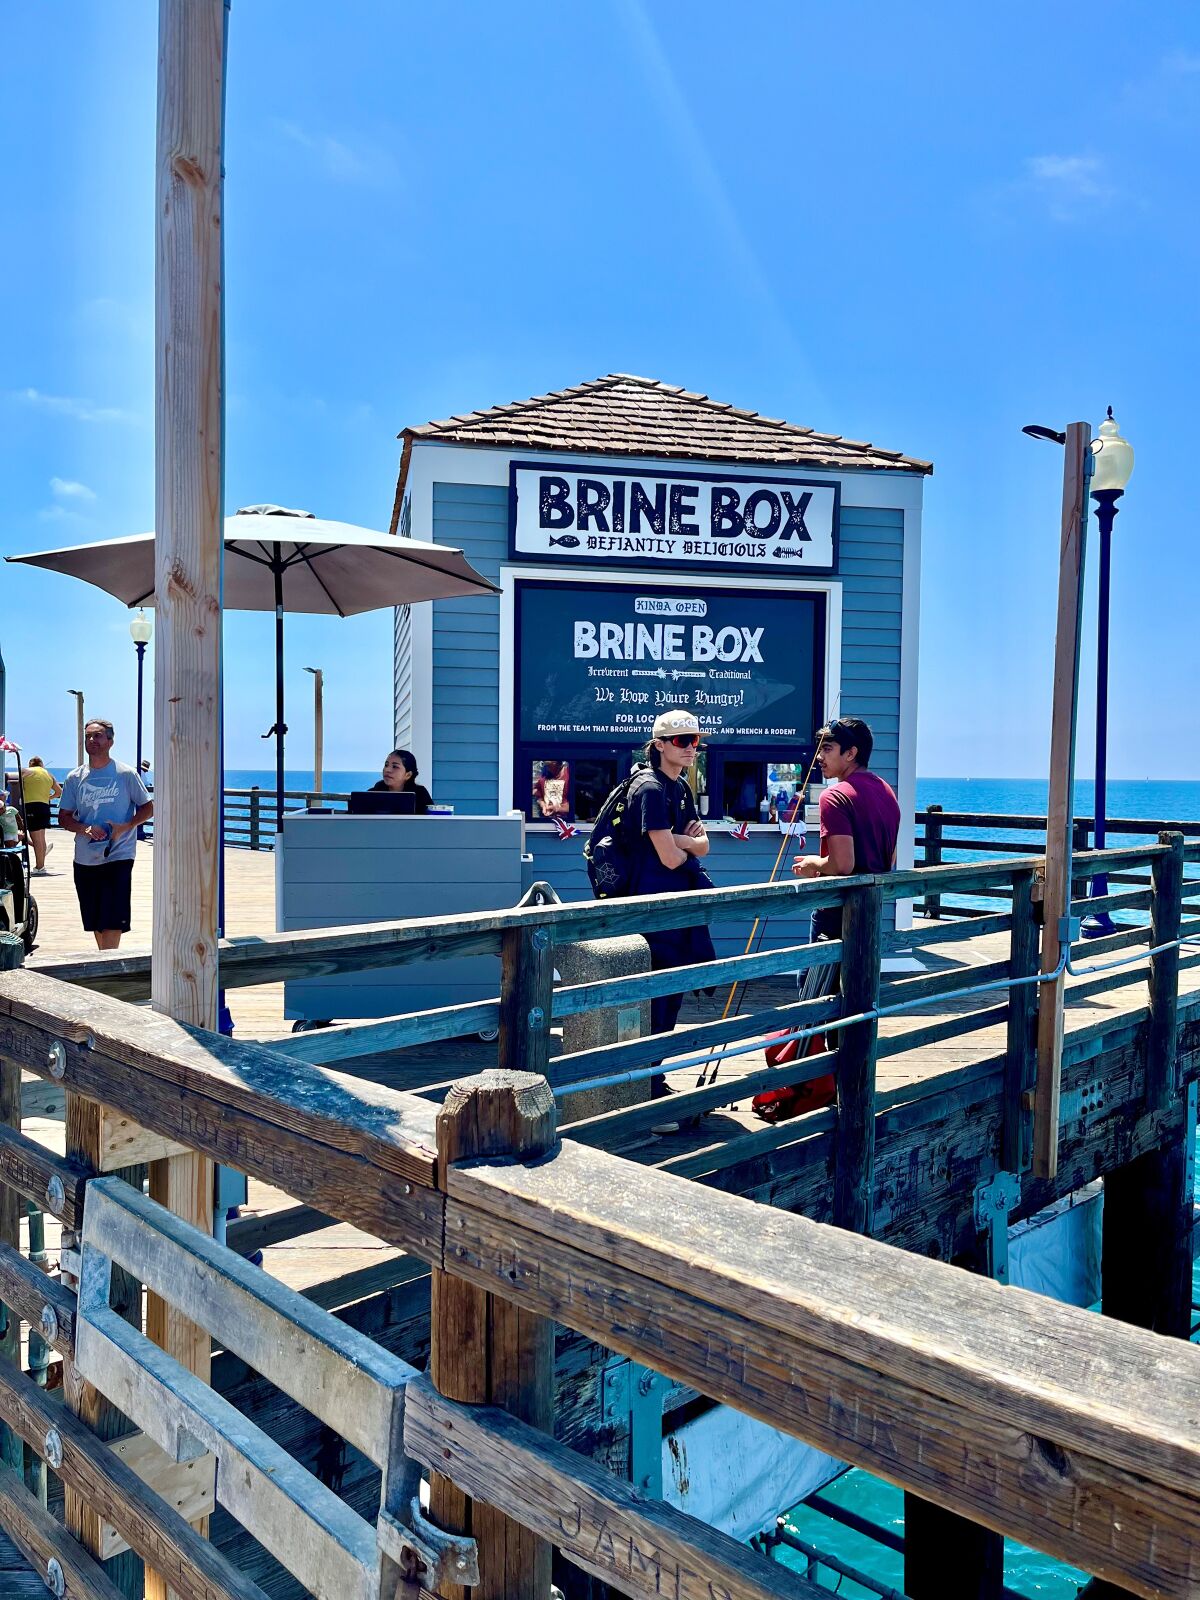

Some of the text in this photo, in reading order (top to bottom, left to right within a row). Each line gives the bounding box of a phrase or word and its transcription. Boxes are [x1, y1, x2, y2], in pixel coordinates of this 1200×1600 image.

[540, 476, 814, 542] BRINE BOX
[587, 535, 766, 558] DEFIANTLY DELICIOUS
[636, 600, 706, 614] KINDA OPEN
[574, 621, 765, 662] BRINE BOX
[588, 666, 752, 680] Irreverent Traditional
[594, 687, 615, 702] We
[620, 688, 650, 704] Hope
[695, 689, 745, 707] Hungry!
[615, 714, 634, 723] FOR
[696, 715, 723, 725] CALS
[537, 724, 557, 732] FROM
[559, 724, 571, 732] THE
[770, 728, 797, 736] RODENT
